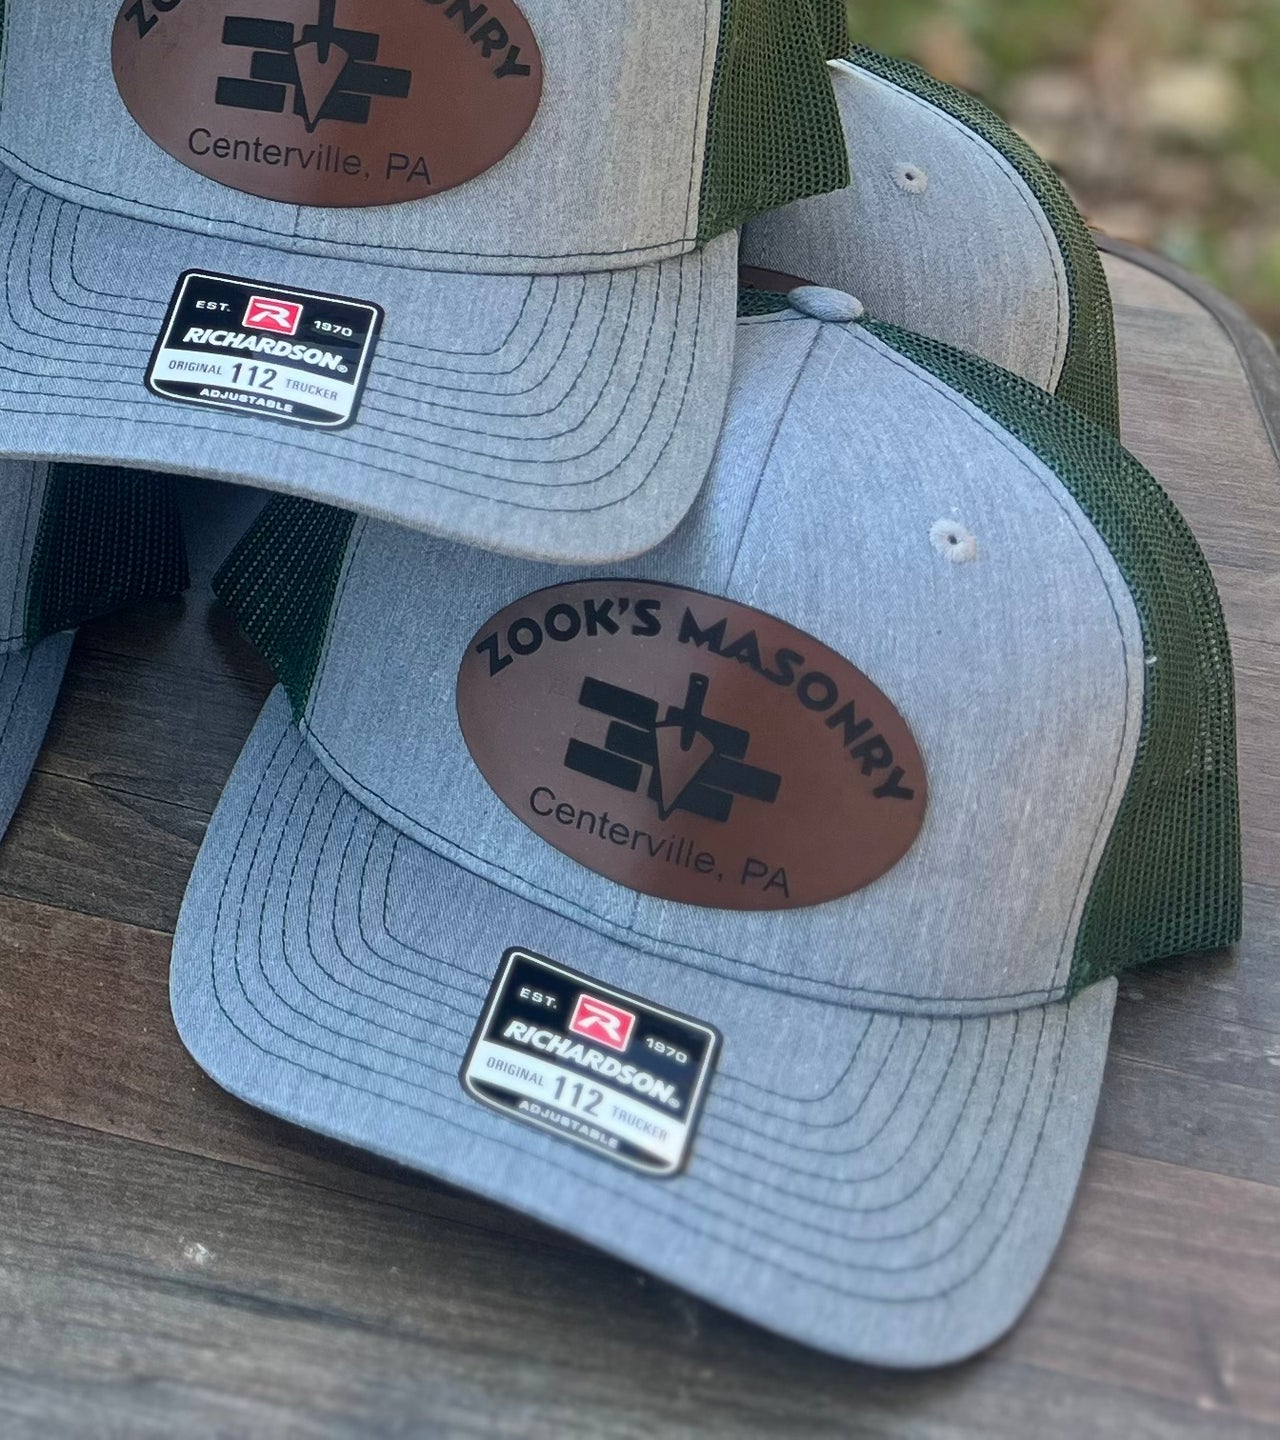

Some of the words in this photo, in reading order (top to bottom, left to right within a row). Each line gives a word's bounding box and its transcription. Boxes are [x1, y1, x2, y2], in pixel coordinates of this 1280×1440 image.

[188, 128, 370, 180] Centerville,
[386, 153, 432, 185] PA
[196, 300, 231, 312] EST.
[314, 320, 353, 337] 1970
[168, 360, 223, 375] ORIGINAL
[231, 363, 278, 390] 112
[286, 378, 338, 401] TRUCKER
[200, 388, 293, 413] ADJUSTABLE
[476, 598, 662, 677] ZOOK'S
[678, 606, 914, 802] MASONRY
[529, 786, 724, 882] Centerville,
[740, 858, 791, 898] PA
[519, 987, 557, 1009] EST.
[645, 1037, 688, 1064] 1970
[486, 1057, 545, 1087] ORIGINAL
[554, 1074, 604, 1117] 112
[612, 1105, 668, 1141] TRUCKER
[518, 1100, 619, 1149] ADJUSTABLE
